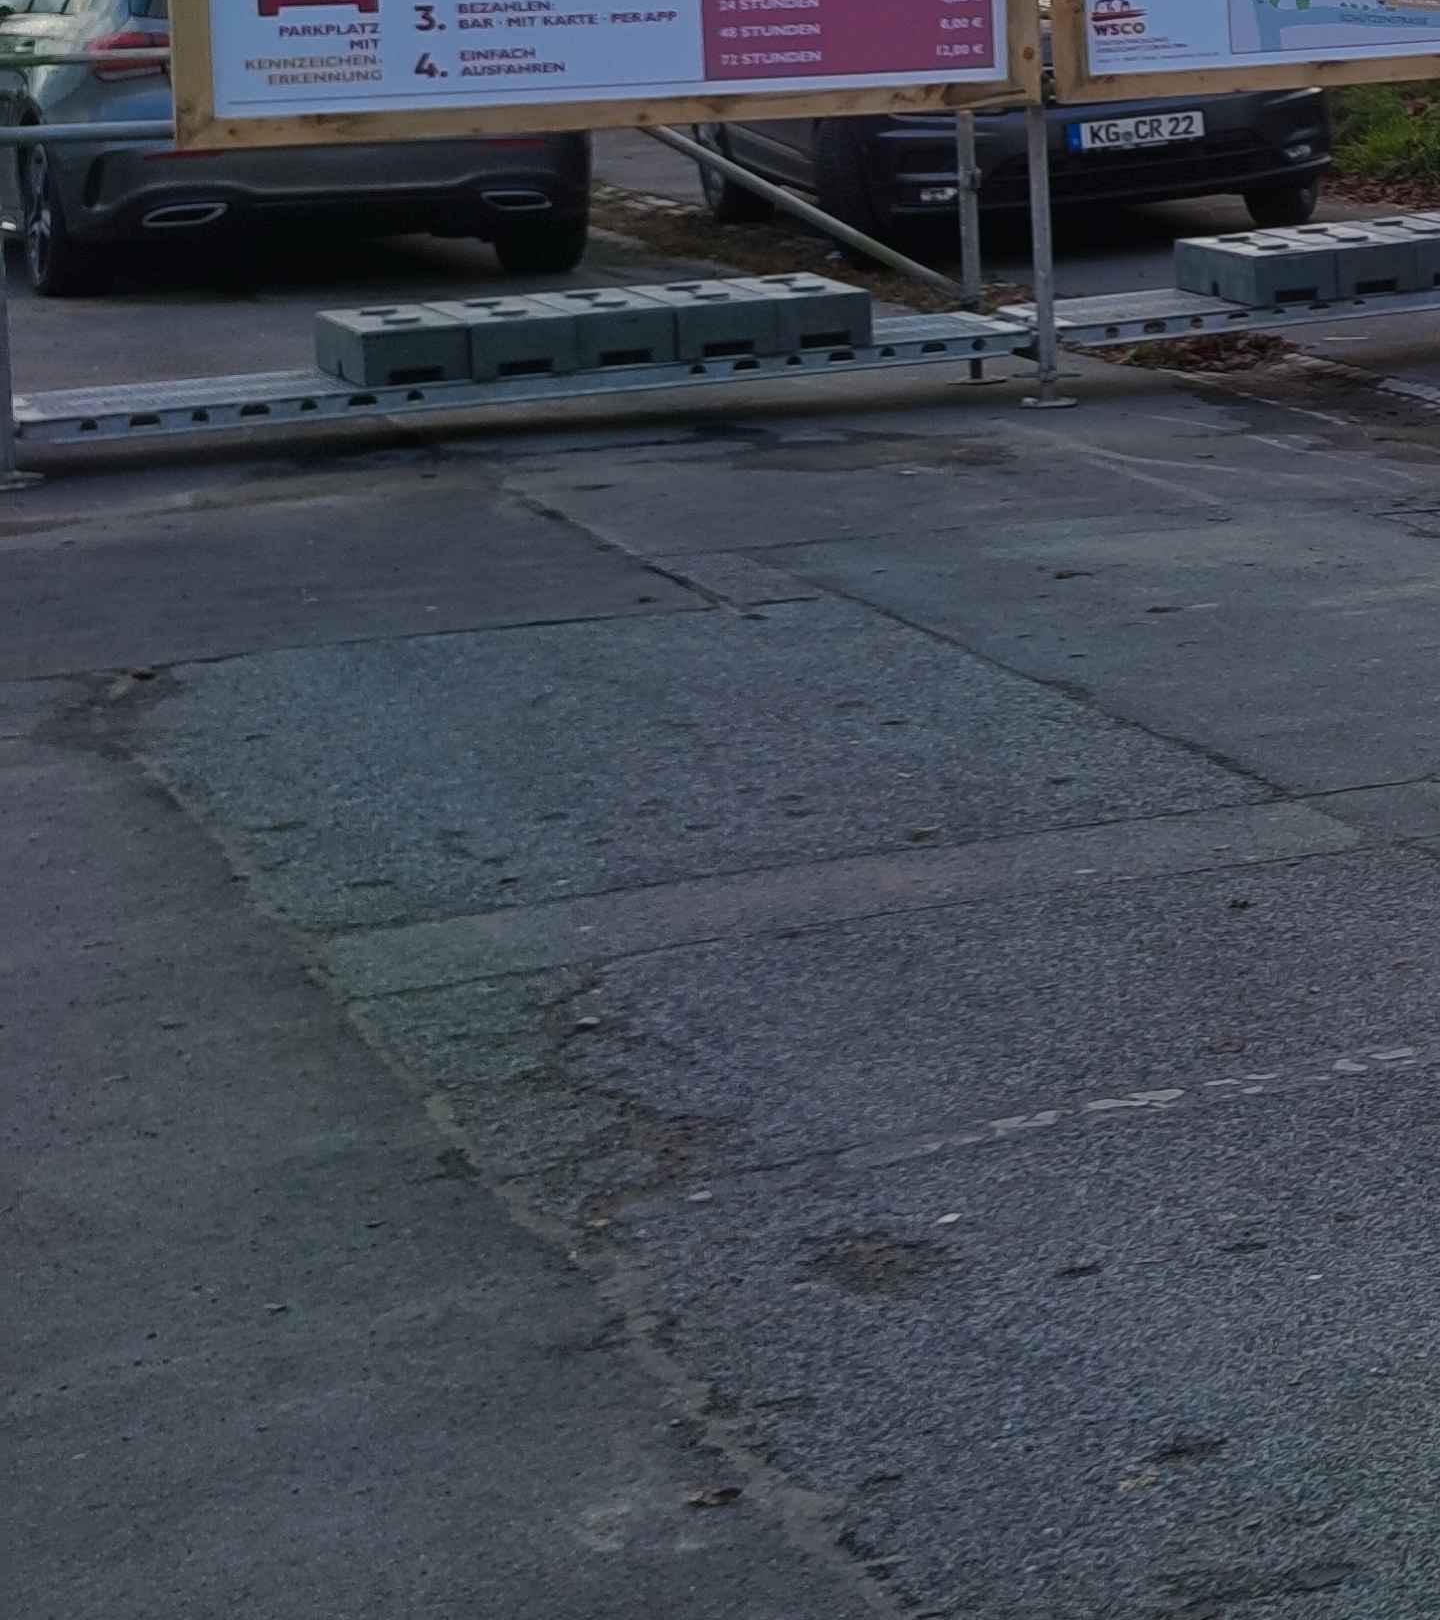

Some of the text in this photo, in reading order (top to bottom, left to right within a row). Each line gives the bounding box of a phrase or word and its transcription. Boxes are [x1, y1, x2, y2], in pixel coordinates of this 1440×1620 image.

[458, 1, 557, 16] BEZAHLEN:
[414, 4, 446, 31] 3.
[459, 18, 496, 31] BAR
[510, 16, 540, 29] MIT
[543, 14, 599, 28] KARTE
[643, 11, 678, 25] APP
[970, 17, 984, 30] €
[279, 23, 380, 38] PARKPLATZ
[740, 23, 822, 39] STUNDEN
[1092, 22, 1146, 37] WSCO
[349, 39, 380, 51] MIT
[971, 42, 985, 56] €
[460, 47, 536, 61] EINFACH
[741, 50, 822, 66] STUNDEN
[413, 51, 449, 79] 4.
[460, 61, 567, 77] AUSFAHREN
[267, 70, 383, 87] ERKENNUNG
[1089, 114, 1195, 145] KG CR 22
